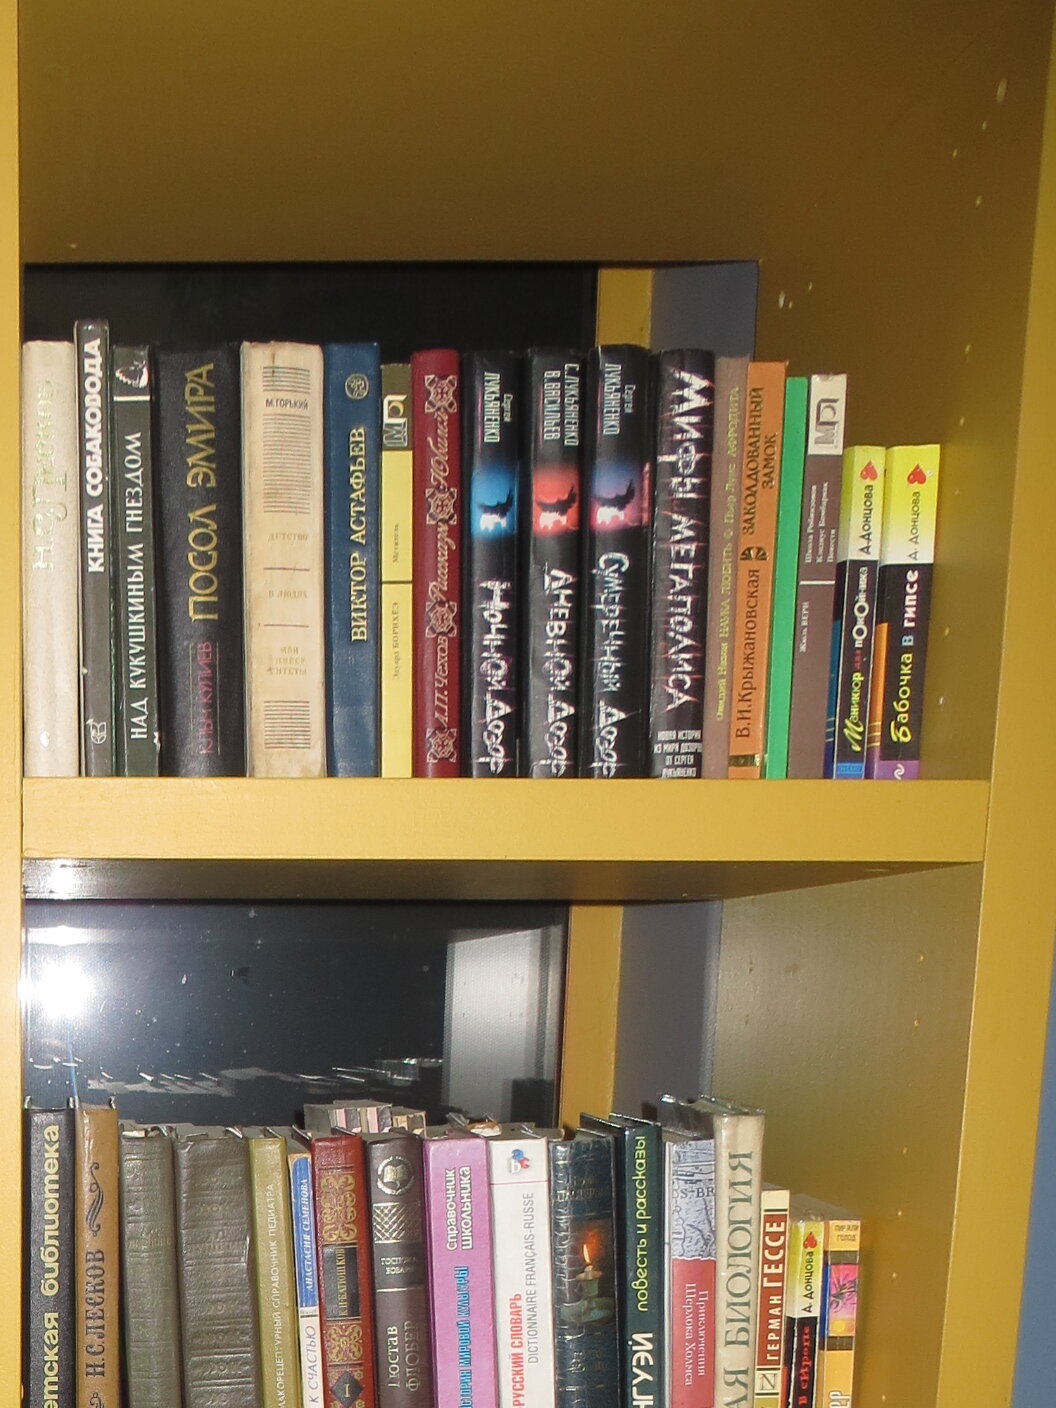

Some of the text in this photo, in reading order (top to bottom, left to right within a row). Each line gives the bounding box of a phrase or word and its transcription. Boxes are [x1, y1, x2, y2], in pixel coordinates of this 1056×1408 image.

[483, 371, 502, 443] ЛУКЬЯНЕНКО
[543, 369, 561, 441] В.ВАСИЛЬЕВ
[563, 362, 581, 446] С.ЛУКЬЯНЕНКО
[603, 362, 622, 436] ЛУКЬЯНЕНКО
[658, 365, 714, 499] МИФЫ
[83, 338, 105, 573] КНИГА СОБАКОВОДА
[185, 362, 219, 622] ПОСОЛ ЭМИРА
[743, 387, 765, 537] ЗАКОЛДОВАННЫЙ
[761, 433, 778, 491] ЗАМОК
[348, 427, 368, 642] ВИКТОР АСТАФЬЕВ
[908, 490, 922, 542] Донцова
[124, 431, 149, 740] НАД КУКУШКИНЫМ ГНЕЗДОМ
[660, 509, 705, 714] МЕГАПОЛИСА
[196, 640, 214, 704] КУЛИЕВ
[735, 568, 762, 739] В.И.Крыжановская
[889, 568, 919, 743] Бабочка в гипсе
[843, 672, 865, 752] Маникюр
[41, 1124, 60, 1297] библиотека
[444, 1167, 459, 1251] Справочник
[457, 1166, 475, 1250] школьника
[634, 1135, 652, 1219] рассказы
[265, 1182, 282, 1309] СПРАВОЧНИК ПЕДИАТРА
[299, 1178, 315, 1292] АНАСТАСИЯ СЕМЕНОВА
[635, 1223, 648, 1233] и
[721, 1149, 754, 1350] БИОЛОГИЯ
[759, 1220, 786, 1288] ГЕССЕ
[522, 1192, 539, 1364] DICTIONNAIRE FRANÇAIS-RUSSE
[631, 1237, 650, 1312] повесть
[802, 1251, 816, 1300] Донцова
[305, 1325, 320, 1391] СЧАСТЬЮ
[402, 1319, 421, 1392] ФЛОБЕР
[507, 1293, 524, 1349] СЛОВАРЬ
[683, 1282, 698, 1386] Шерлока Холмса
[697, 1289, 711, 1376] Приключения
[766, 1294, 782, 1361] ГЕРМАН
[308, 1395, 320, 1404] К
